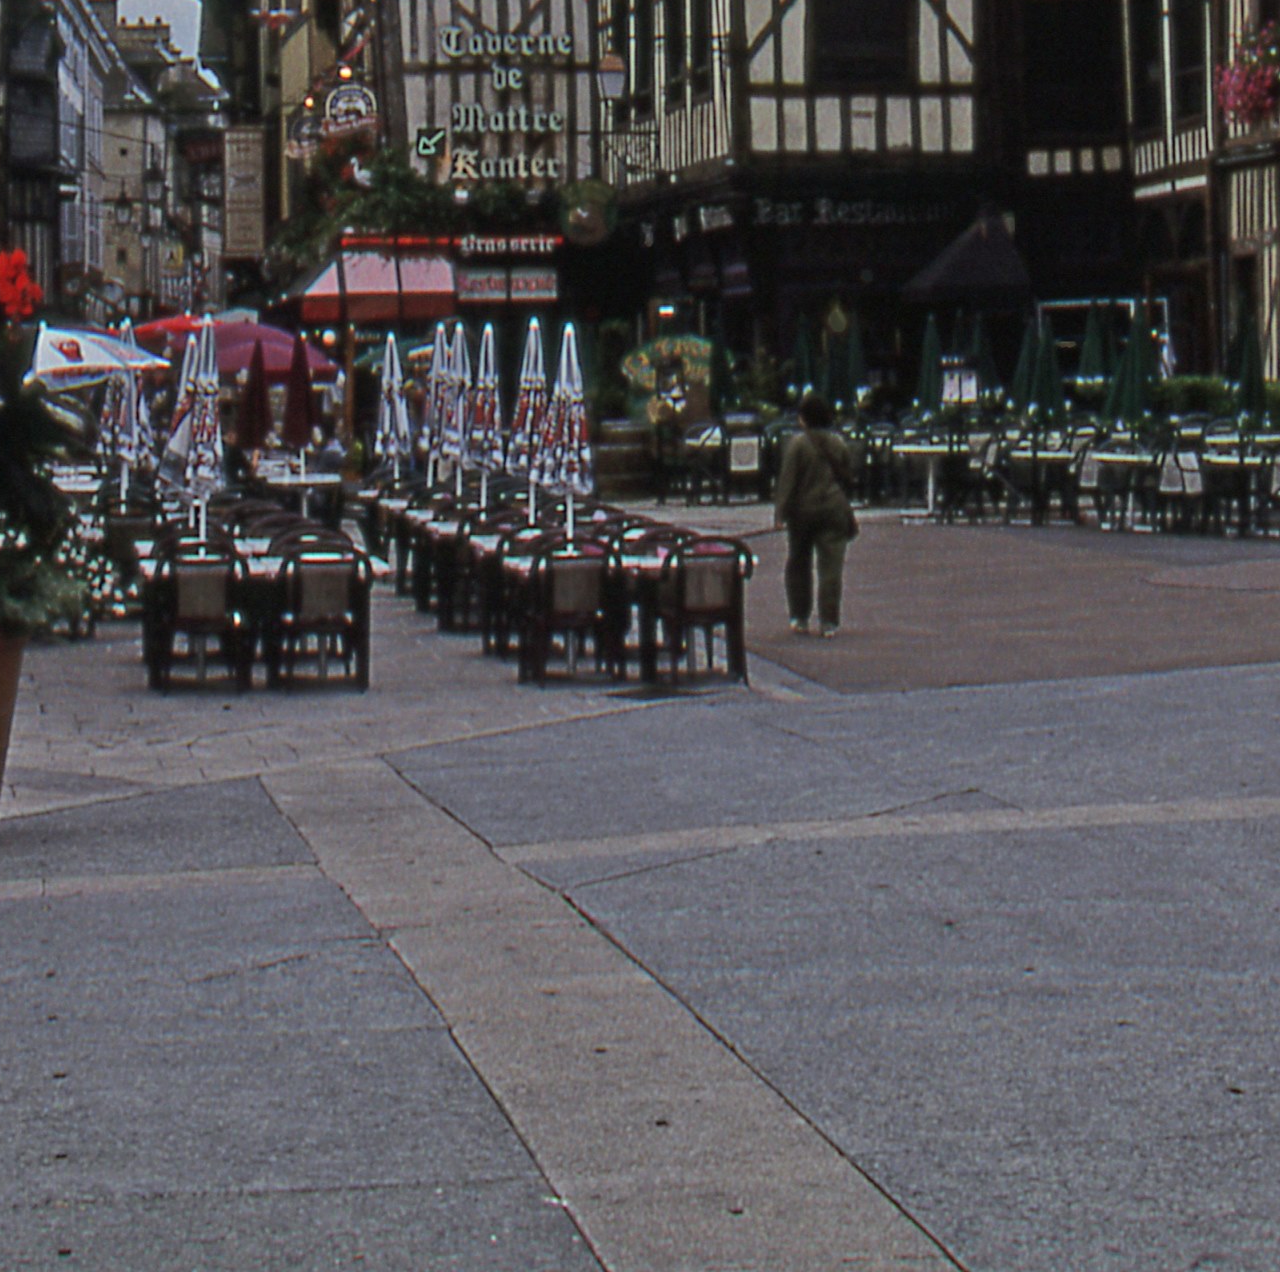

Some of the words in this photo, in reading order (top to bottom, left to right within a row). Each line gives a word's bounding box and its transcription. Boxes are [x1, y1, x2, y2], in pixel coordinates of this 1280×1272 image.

[441, 25, 572, 57] Taverne
[491, 61, 522, 90] de
[451, 147, 561, 179] Kanter
